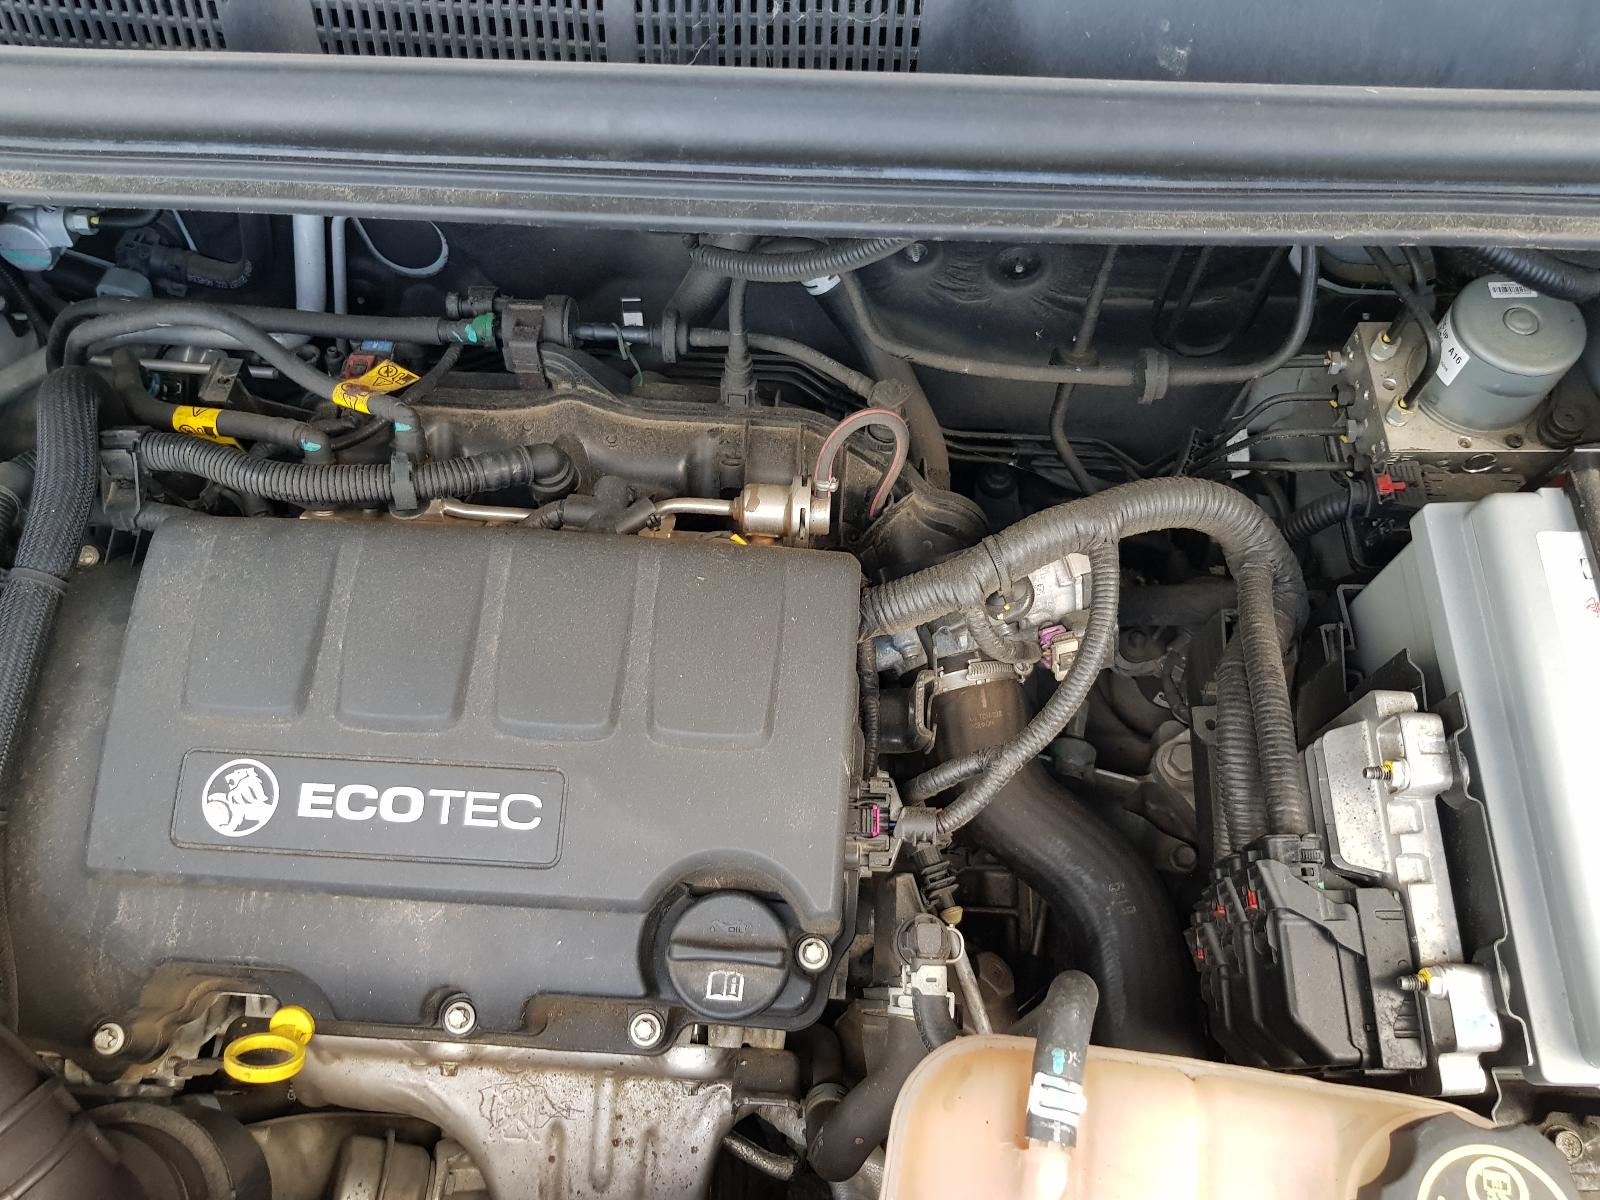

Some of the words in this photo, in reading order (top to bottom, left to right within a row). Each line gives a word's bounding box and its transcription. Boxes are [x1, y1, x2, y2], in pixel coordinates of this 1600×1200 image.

[1448, 347, 1462, 365] A16
[297, 782, 543, 831] ECOTEC
[728, 926, 745, 934] OIL
